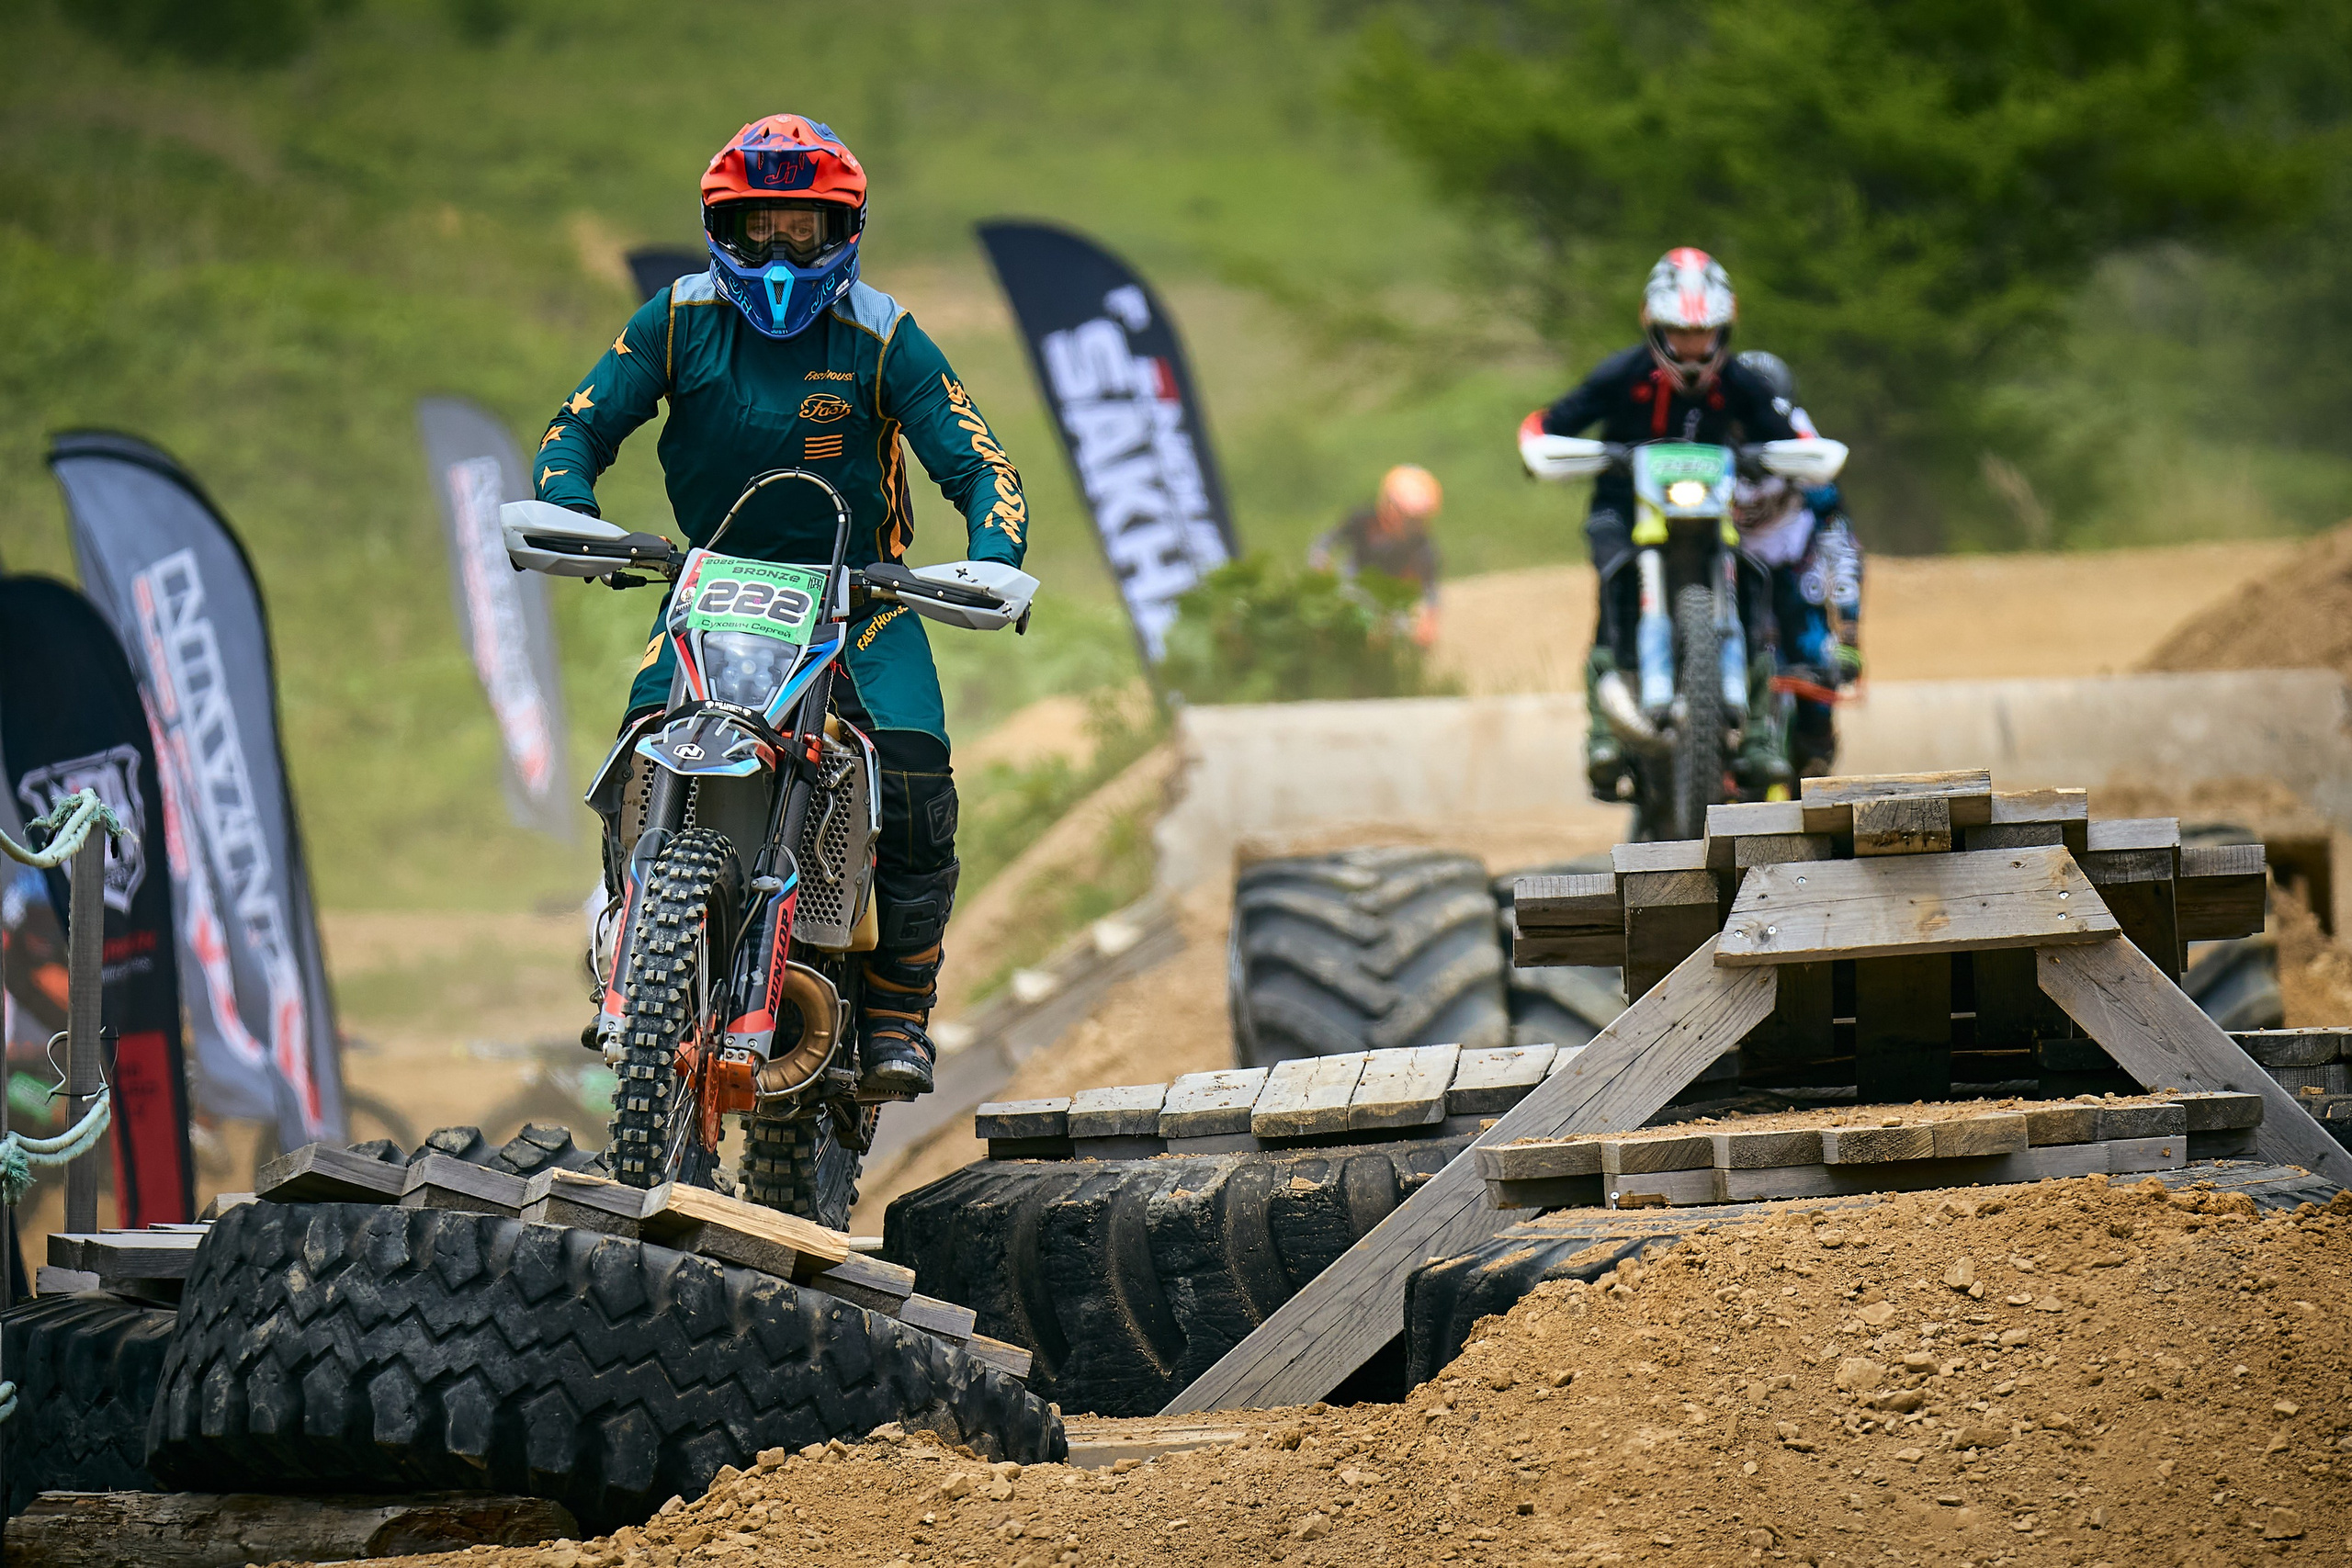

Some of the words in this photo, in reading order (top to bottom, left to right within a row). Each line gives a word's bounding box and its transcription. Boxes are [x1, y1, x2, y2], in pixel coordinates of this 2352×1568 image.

[695, 580, 812, 626] 222
[751, 622, 792, 638] Сергей
[768, 908, 790, 1020] DUNLOP
